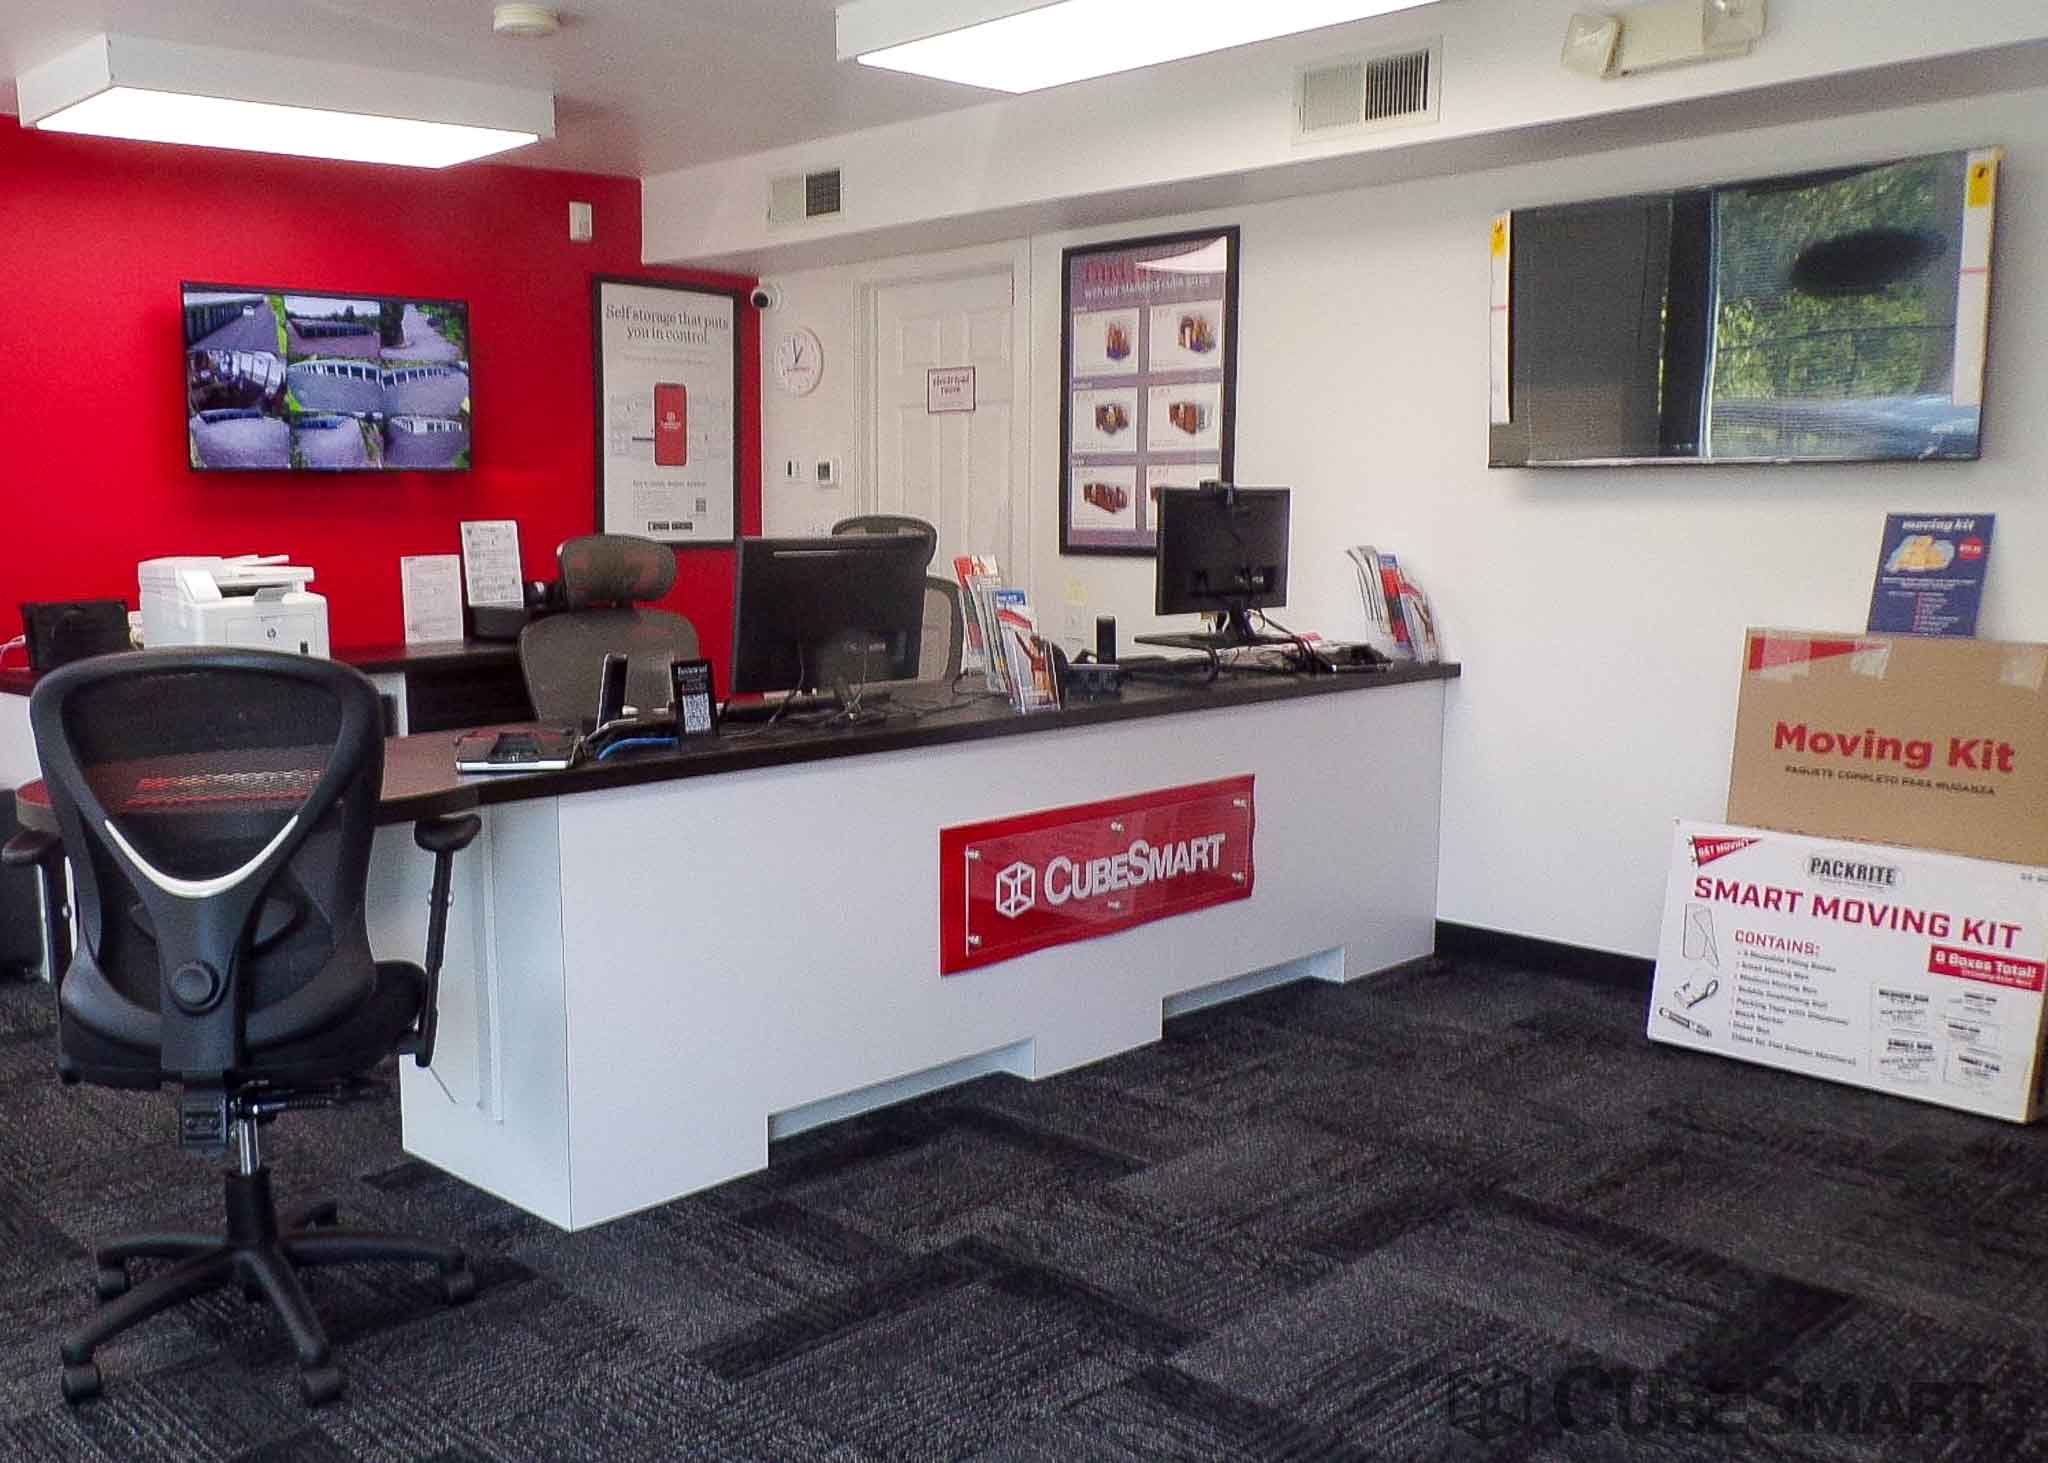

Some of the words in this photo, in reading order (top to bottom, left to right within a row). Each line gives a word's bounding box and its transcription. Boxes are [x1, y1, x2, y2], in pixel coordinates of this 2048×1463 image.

[633, 308, 676, 328] storage
[1774, 720, 1935, 770] Moving
[1947, 735, 2016, 773] Kit
[1809, 856, 1898, 886] PACKRITE
[1694, 877, 1804, 913] SMART
[1812, 895, 1951, 938] MOVING
[1961, 916, 2024, 949] KIT
[1735, 928, 1821, 955] CONTAINS:
[1948, 953, 1992, 972] Boxes
